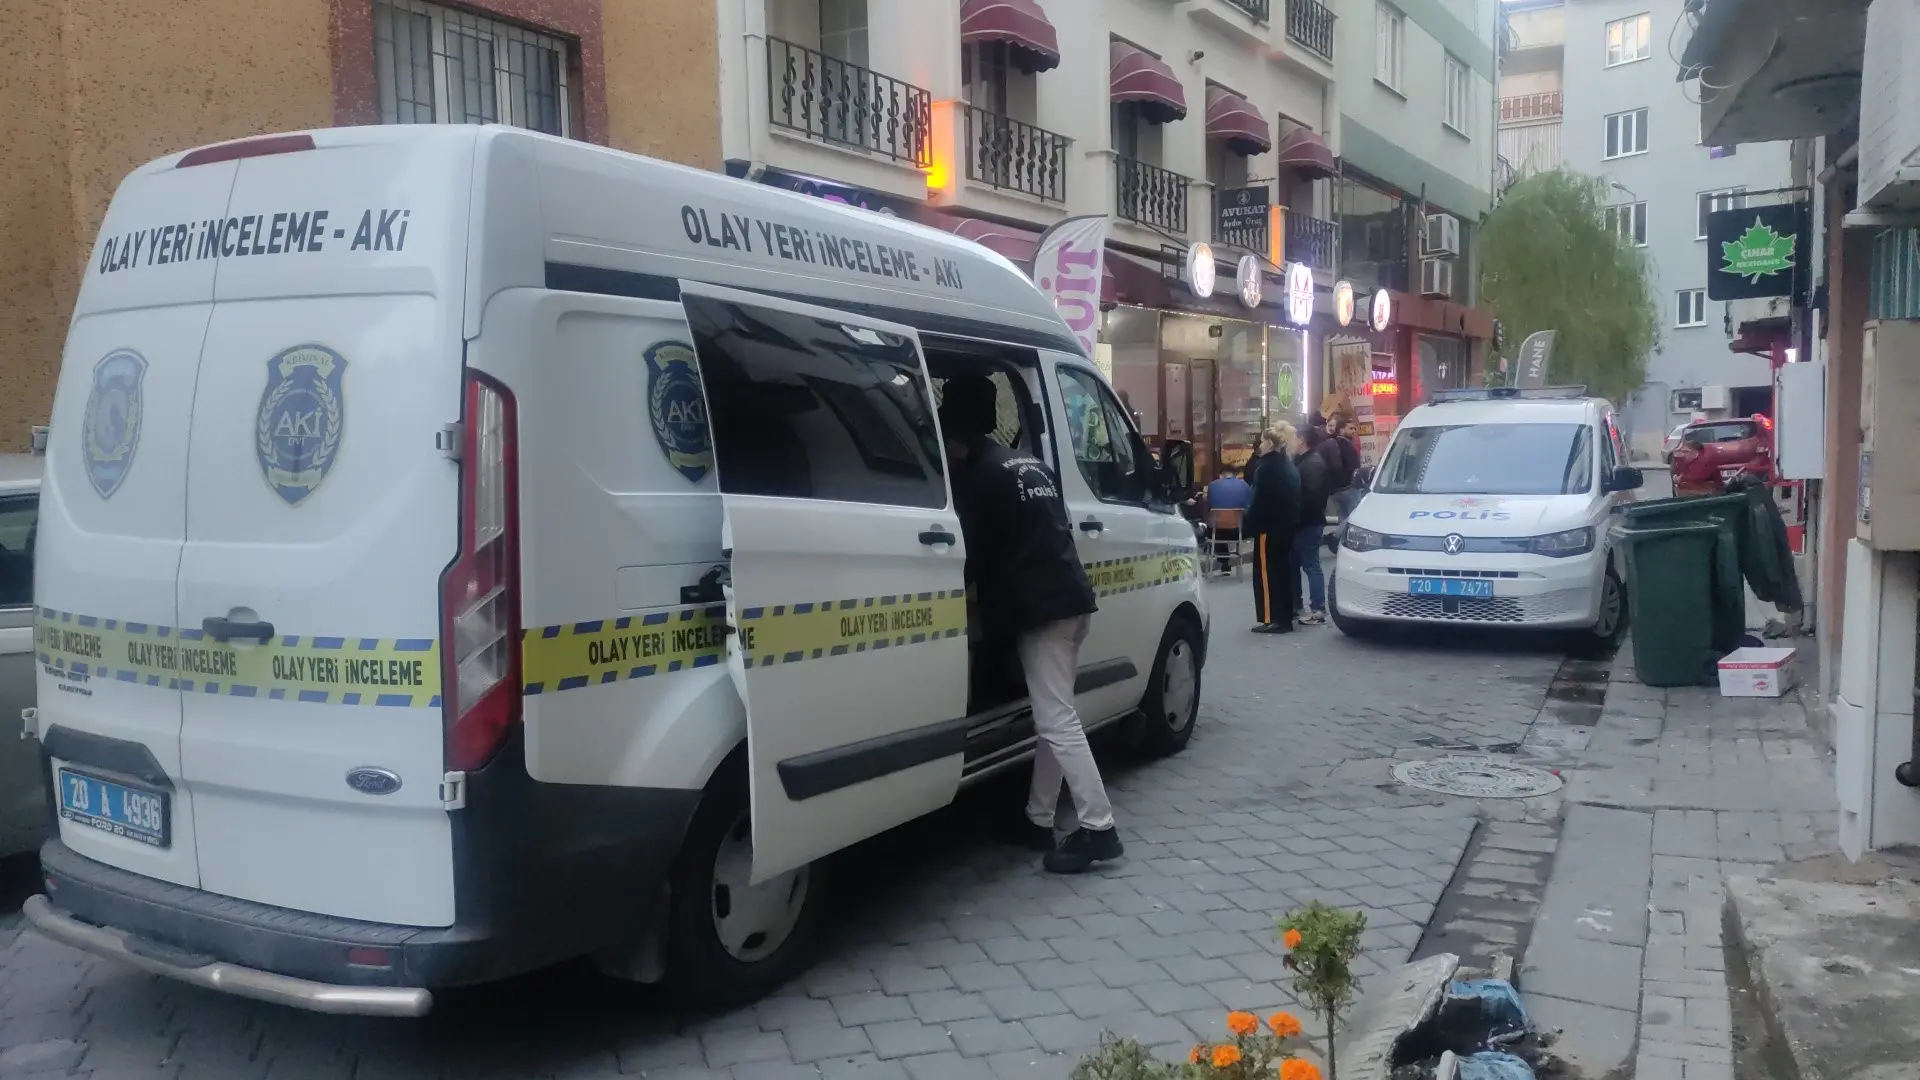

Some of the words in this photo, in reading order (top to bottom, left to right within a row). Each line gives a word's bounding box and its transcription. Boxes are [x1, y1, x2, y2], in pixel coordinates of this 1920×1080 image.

[1221, 205, 1266, 218] AVUKAT
[681, 205, 752, 252] OLAY
[99, 229, 146, 275] OLAY
[1040, 240, 1098, 354] UİT
[1528, 340, 1546, 378] HANE
[1408, 510, 1512, 521] POLİS
[1417, 580, 1432, 593] 20
[1441, 580, 1448, 593] A
[1460, 581, 1489, 595] 7471
[840, 615, 866, 637] OLAY
[128, 641, 153, 667] OLAY
[588, 636, 630, 666] OLAY
[272, 655, 305, 681] OLAY
[70, 777, 89, 811] 20
[101, 785, 112, 817] A
[123, 790, 160, 831] 4936
[91, 818, 113, 832] FORD
[113, 824, 124, 836] 20
